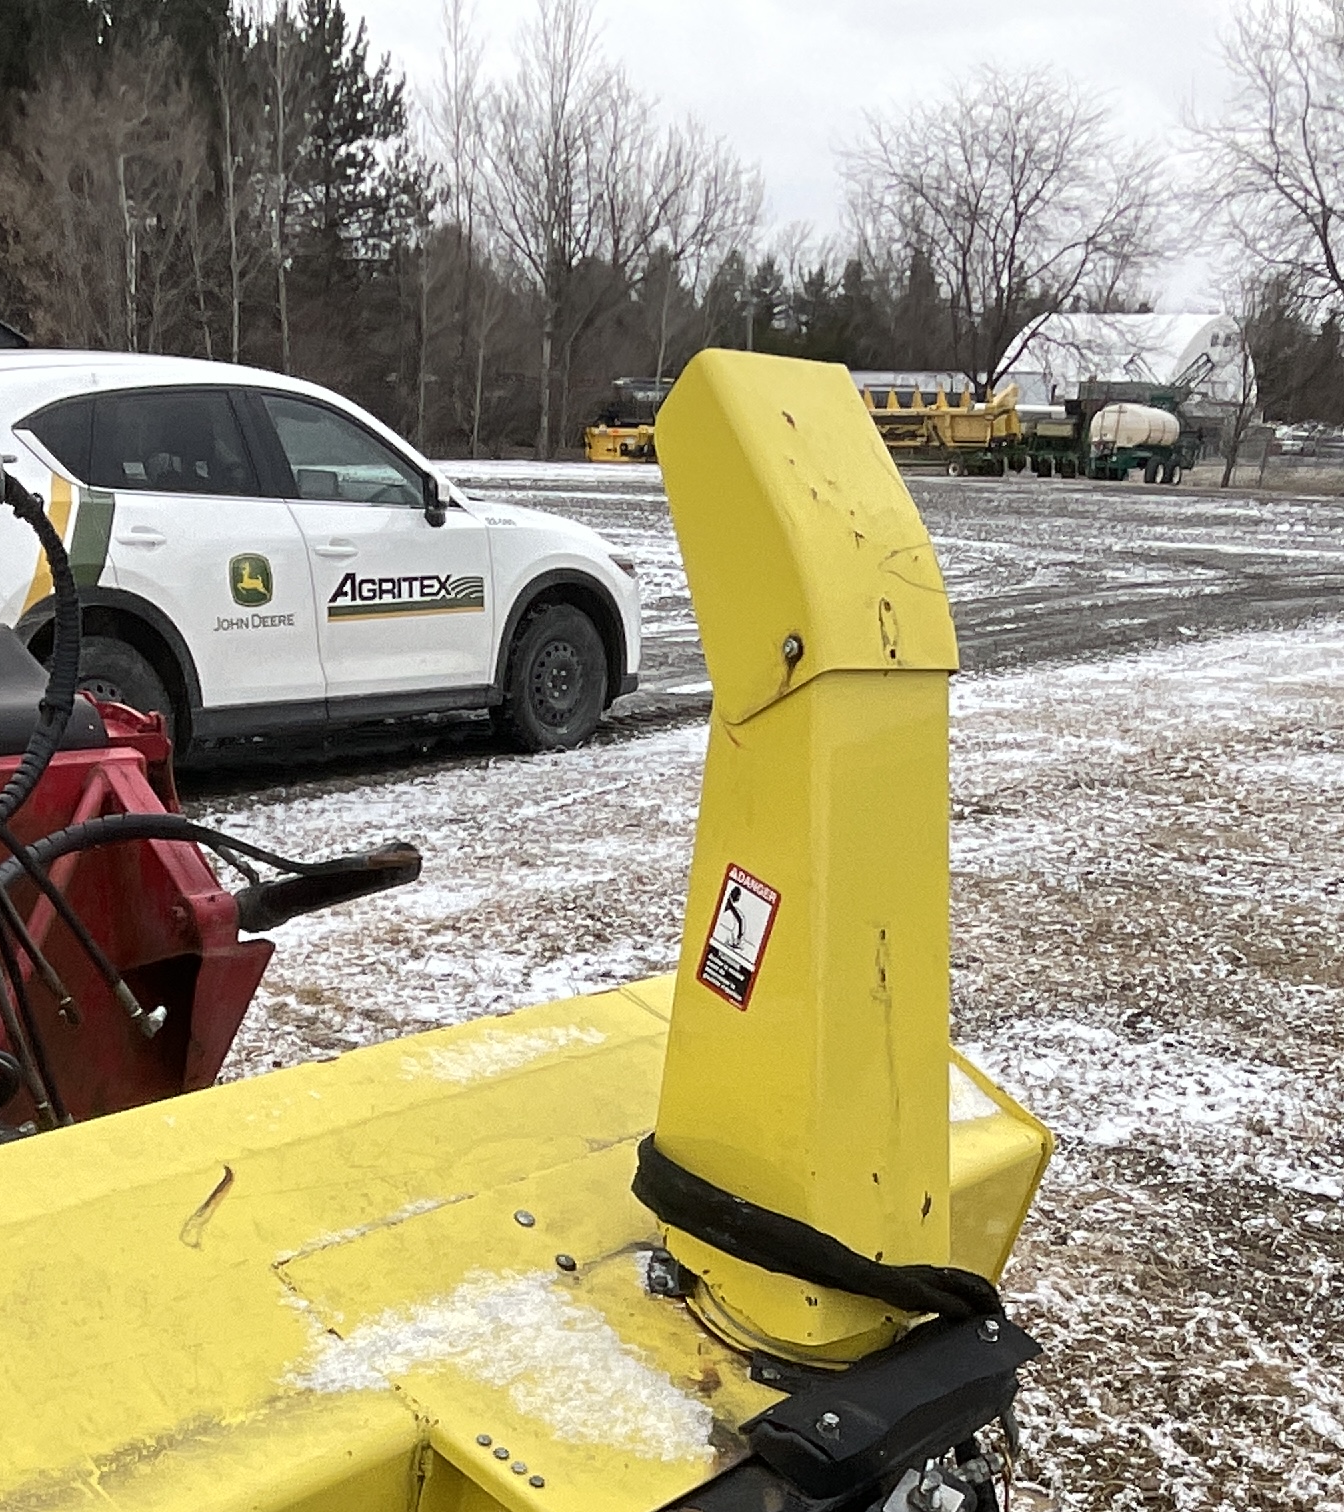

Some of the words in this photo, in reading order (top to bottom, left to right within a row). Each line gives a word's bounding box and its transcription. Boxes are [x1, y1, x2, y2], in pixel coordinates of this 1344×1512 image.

[328, 572, 452, 603] AGRITEX
[213, 616, 249, 632] JOHN
[251, 614, 295, 629] DEERE
[737, 871, 777, 904] DANGER
